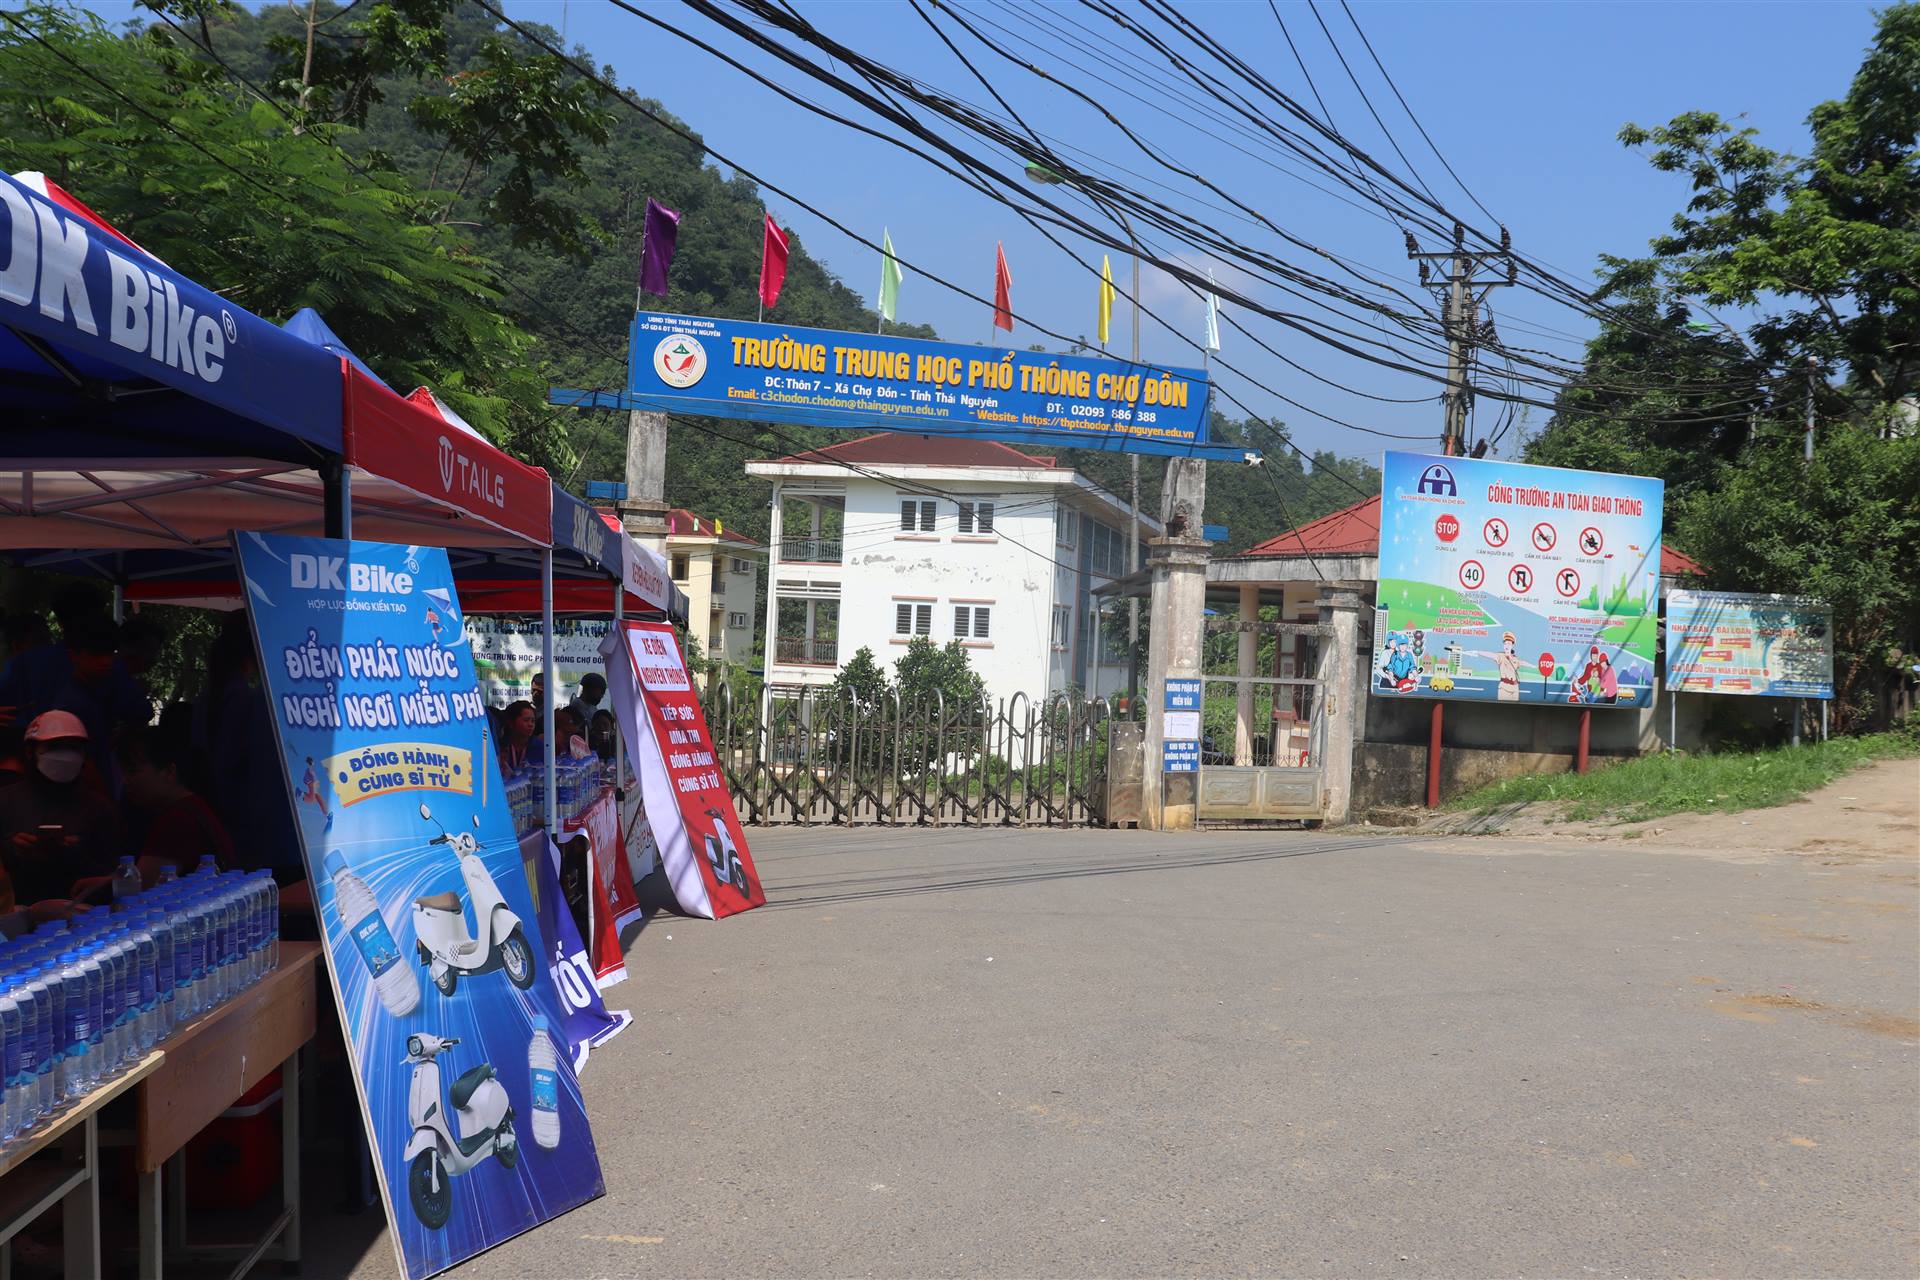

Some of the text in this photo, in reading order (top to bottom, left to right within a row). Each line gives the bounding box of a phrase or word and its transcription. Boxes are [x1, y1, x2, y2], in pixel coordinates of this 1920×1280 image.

[731, 333, 827, 373] TRƯỜNG
[833, 346, 911, 381] TRUNG
[916, 354, 962, 390] HỌC
[968, 351, 1016, 390] PHỔ
[1019, 361, 1091, 399] THÔNG
[1096, 372, 1141, 408] CHỢ
[727, 386, 760, 400] Email:
[764, 376, 998, 408] ĐC: Thôn 7 Xã Chợ Đồn Tỉnh Thái Nguyên
[976, 409, 1019, 423] Website:
[1046, 402, 1157, 423] ĐT: 02093 886 388
[457, 454, 504, 509] TAILG
[1552, 492, 1565, 509] AN
[1592, 495, 1612, 514] GIAO
[1614, 496, 1642, 517] THÔNG
[1437, 522, 1457, 535] STOP
[290, 553, 345, 590] DK
[1465, 568, 1479, 582] 40
[308, 598, 407, 615] HỢP LỰC ĐỒNG KIẾN TẠO
[641, 636, 667, 659] XE ĐIỆN
[346, 640, 400, 679] PHÁT
[404, 642, 458, 678] NƯỚC
[493, 653, 516, 661] TRUNG
[518, 654, 533, 662] HỌC
[535, 654, 544, 662] PH
[576, 656, 591, 664] CHỢ
[1540, 660, 1554, 669] STOP
[660, 702, 695, 721] TIẾP SỨC
[668, 728, 701, 745] MÙA THI
[349, 747, 449, 772] ĐỒNG HÀNH
[669, 749, 714, 769] ĐỒNG HÀNH
[358, 768, 450, 793] CÙNG SĨ TỬ
[678, 772, 720, 793] CÙNG SĨ TỬ
